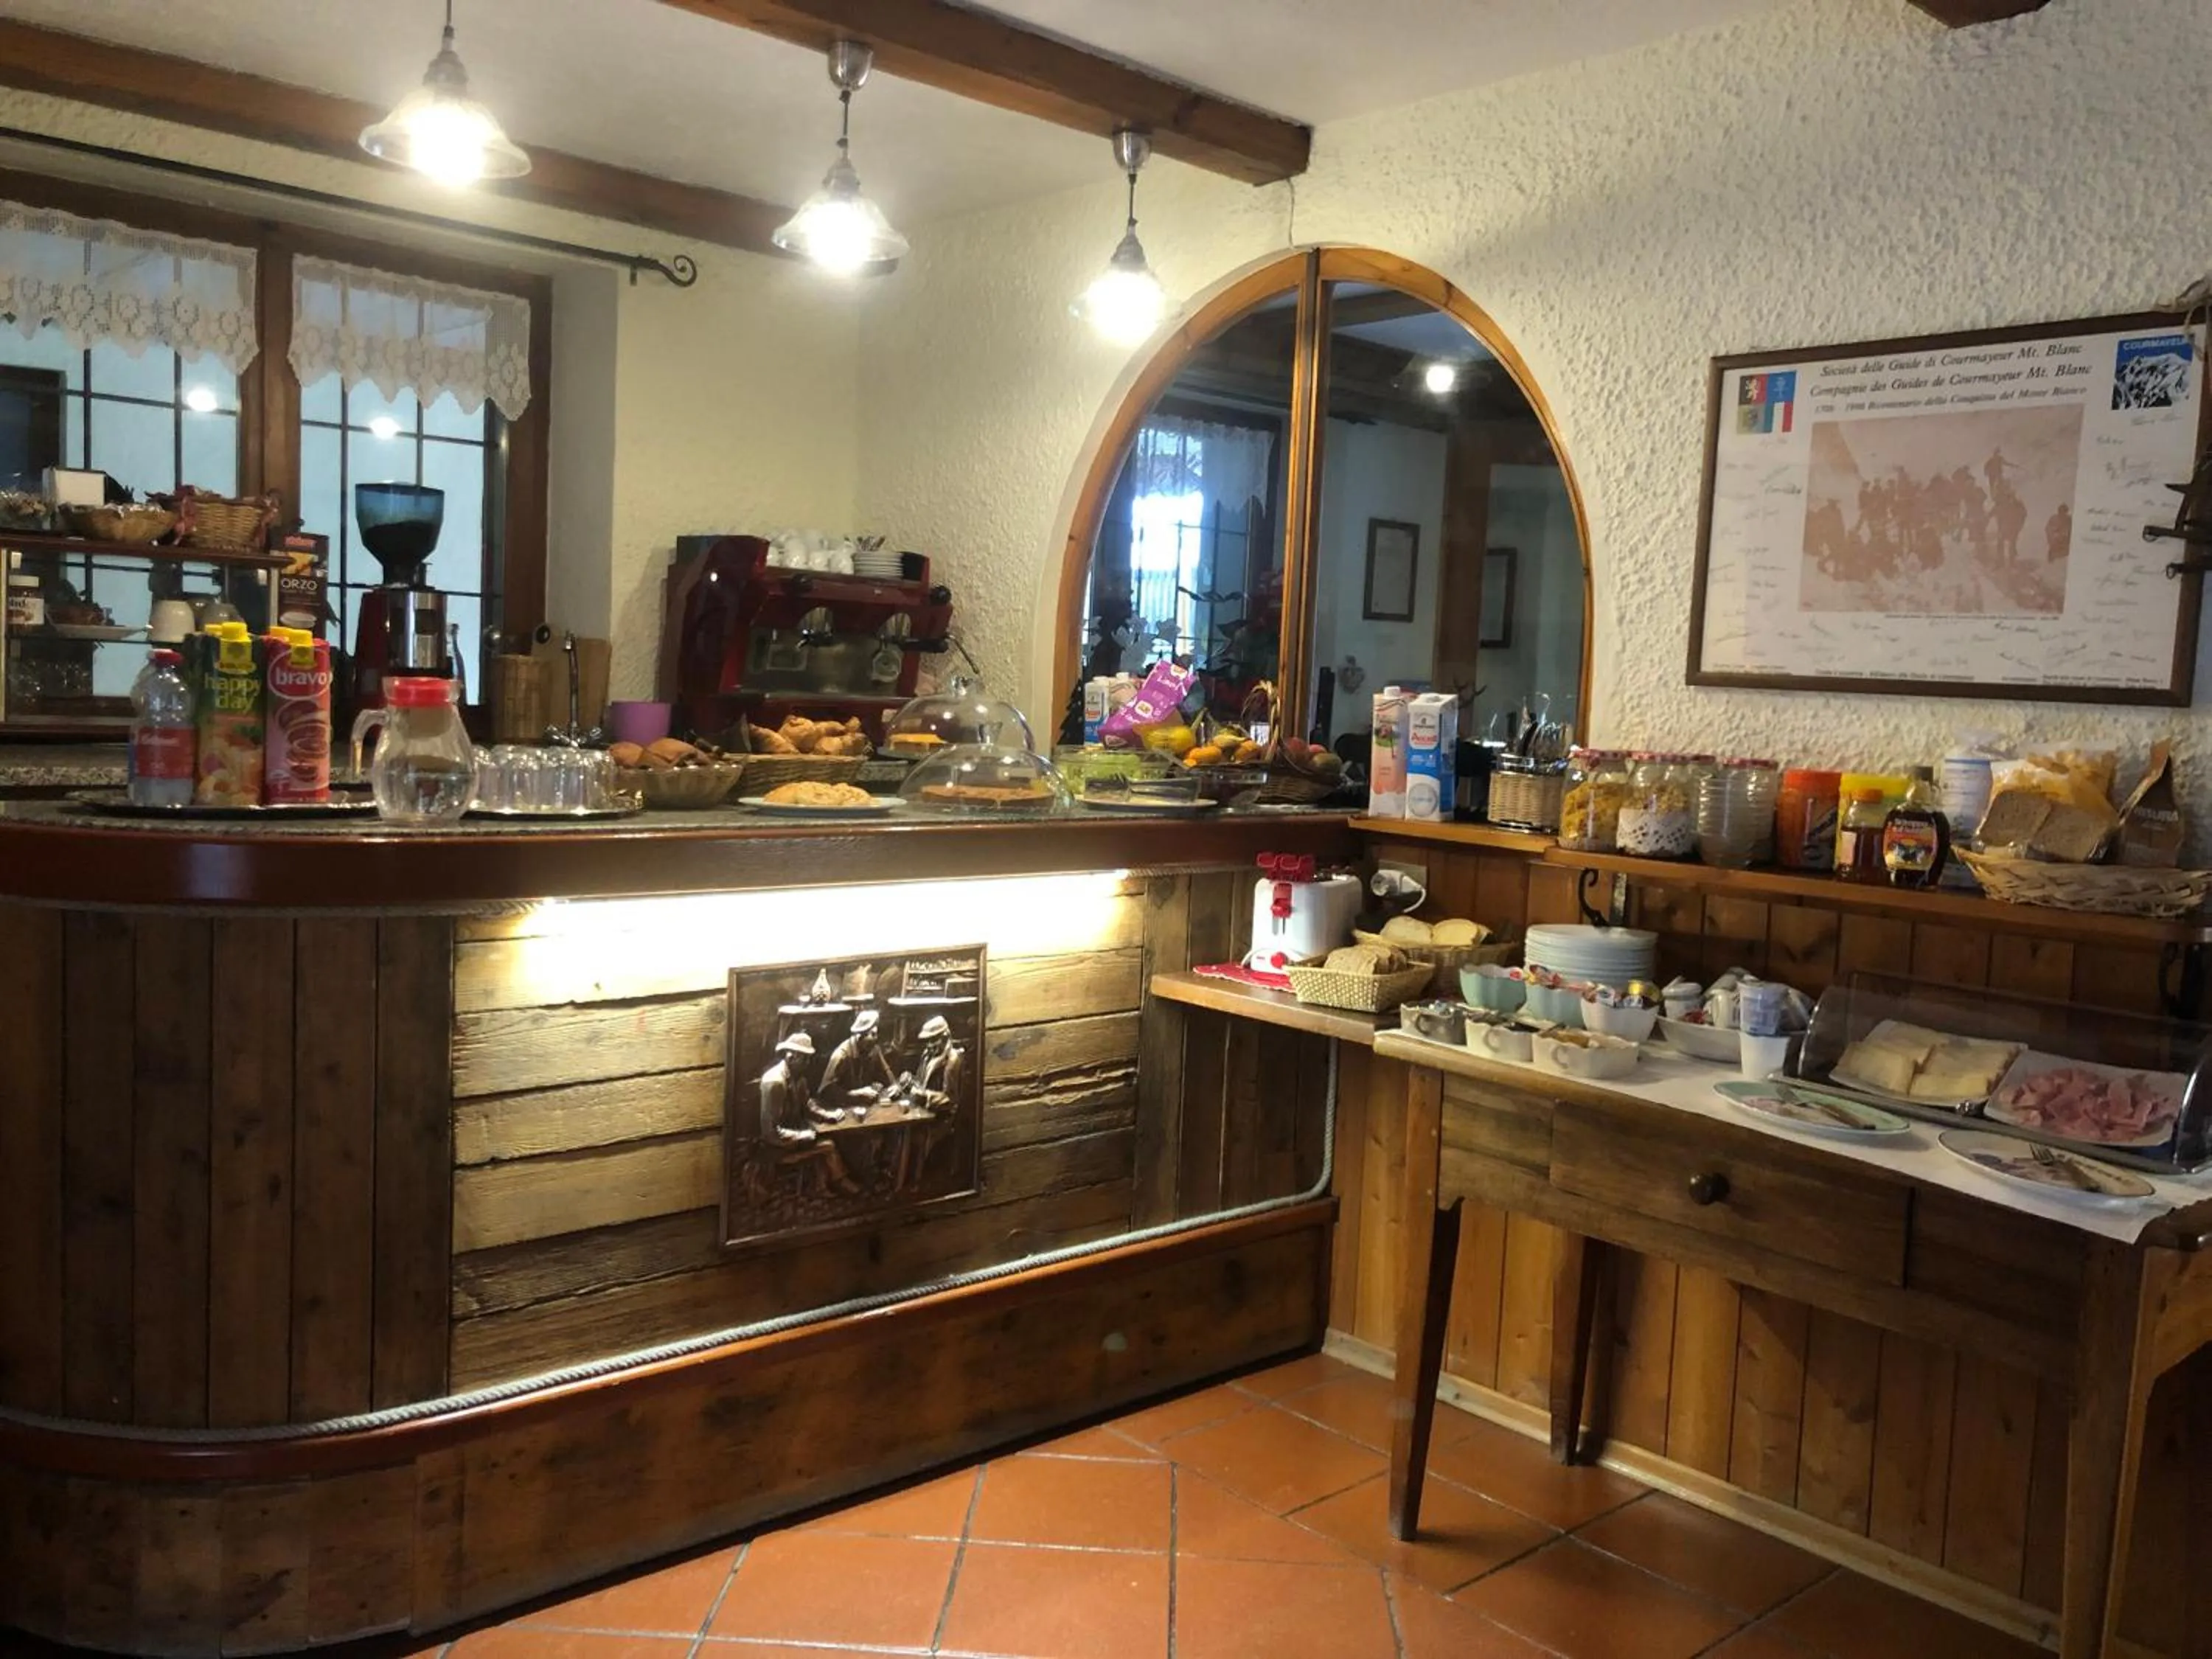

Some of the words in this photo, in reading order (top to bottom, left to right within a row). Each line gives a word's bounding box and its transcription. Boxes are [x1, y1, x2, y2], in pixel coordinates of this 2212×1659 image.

[1888, 357, 1921, 371] Guide
[1941, 350, 2014, 366] Courmayeur
[2017, 347, 2040, 360] Mt.
[2045, 342, 2083, 357] Blanc
[1891, 378, 1929, 391] Guides
[1931, 375, 1945, 387] de
[1949, 370, 2024, 386] Courmayeur
[2026, 366, 2048, 379] Mt.
[2053, 363, 2093, 378] Blanc
[281, 577, 318, 591] ORZO
[204, 672, 262, 697] happy
[275, 667, 327, 686] bravo
[215, 691, 254, 715] day
